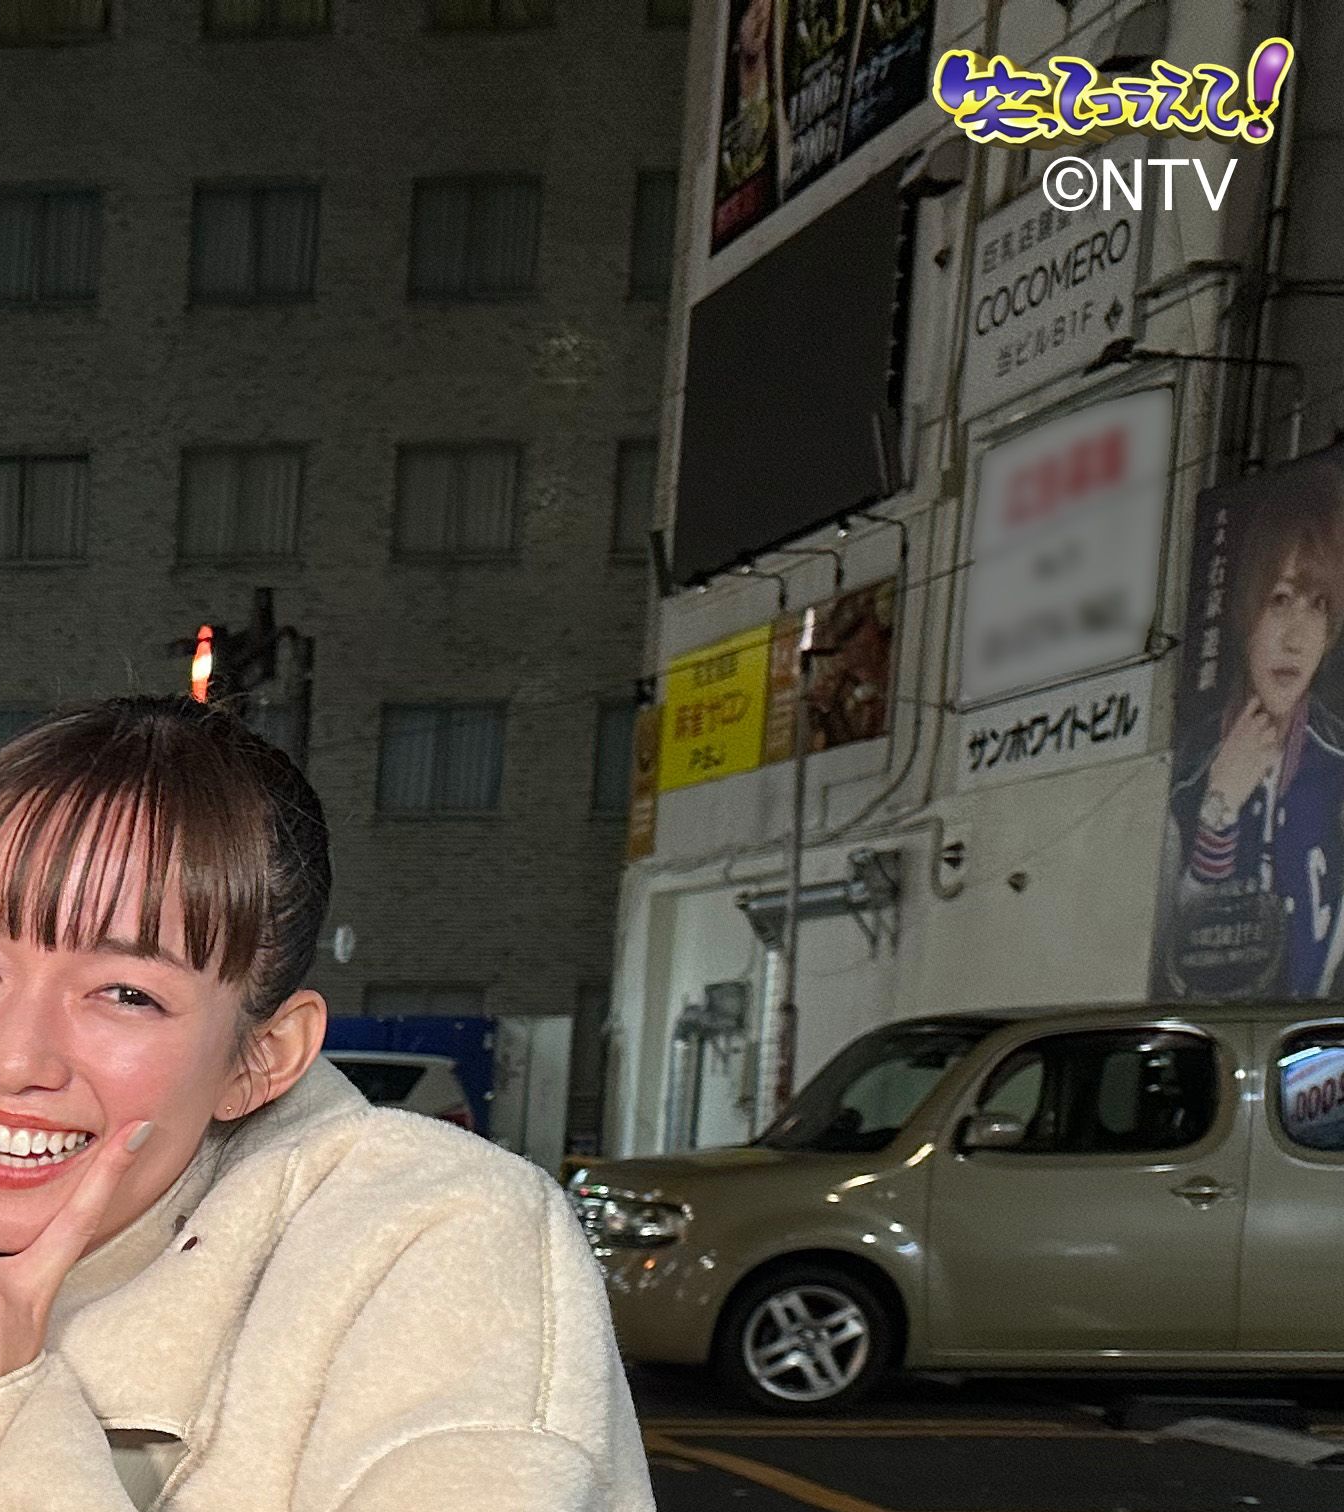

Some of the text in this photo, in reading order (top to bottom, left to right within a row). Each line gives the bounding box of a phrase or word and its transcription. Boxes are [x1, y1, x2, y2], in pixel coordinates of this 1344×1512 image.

[975, 218, 1132, 337] COCOMERO
[967, 691, 1140, 773] サンホワイトビル
